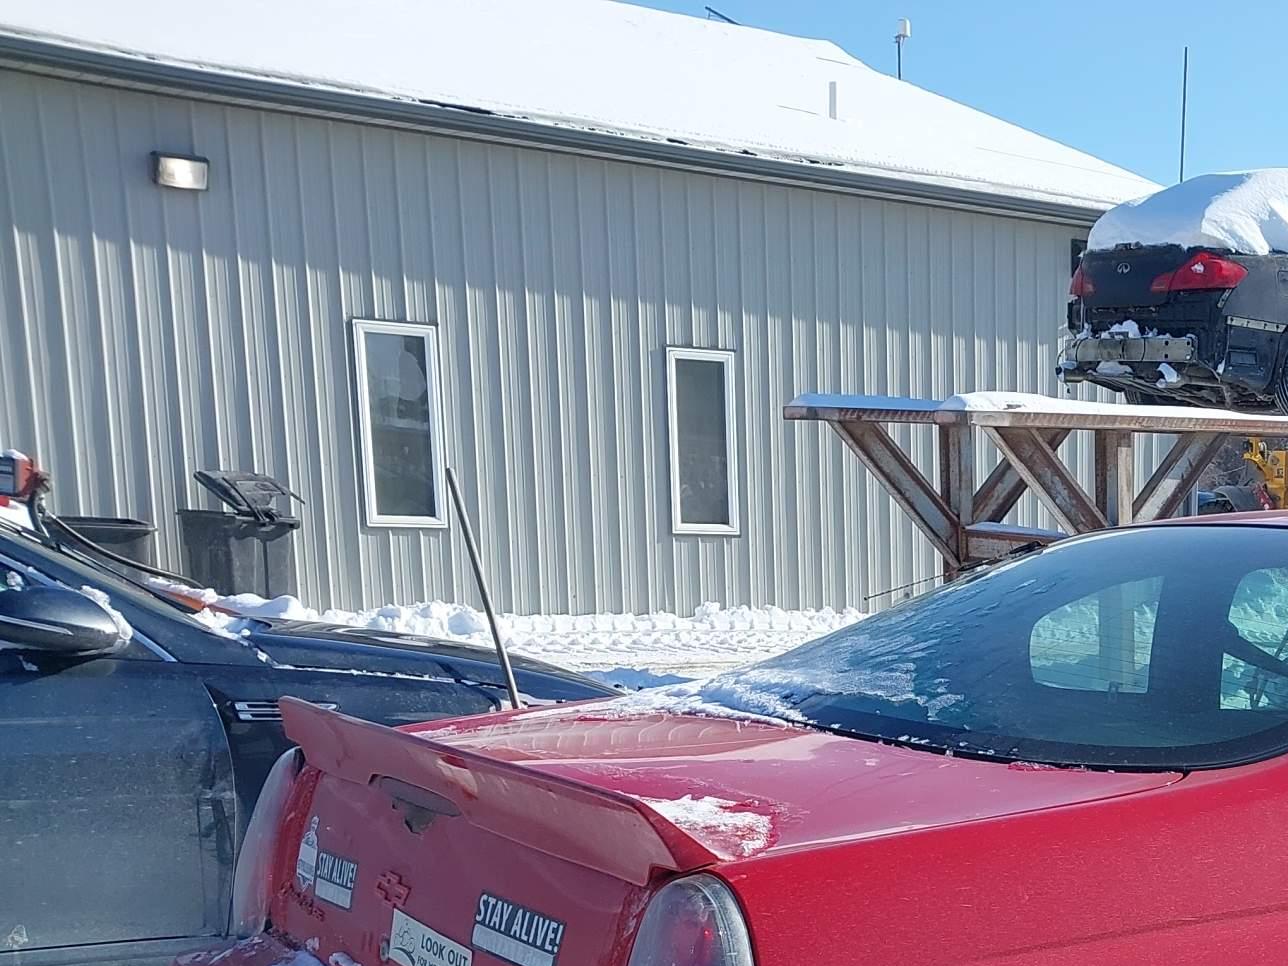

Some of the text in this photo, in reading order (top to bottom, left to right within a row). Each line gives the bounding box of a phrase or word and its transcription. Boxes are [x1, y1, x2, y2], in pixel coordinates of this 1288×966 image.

[316, 851, 335, 881] STAY
[331, 857, 358, 889] ALIVE!
[475, 893, 513, 933] STAY
[510, 908, 564, 954] ALIVE!
[420, 933, 446, 961] LOOK
